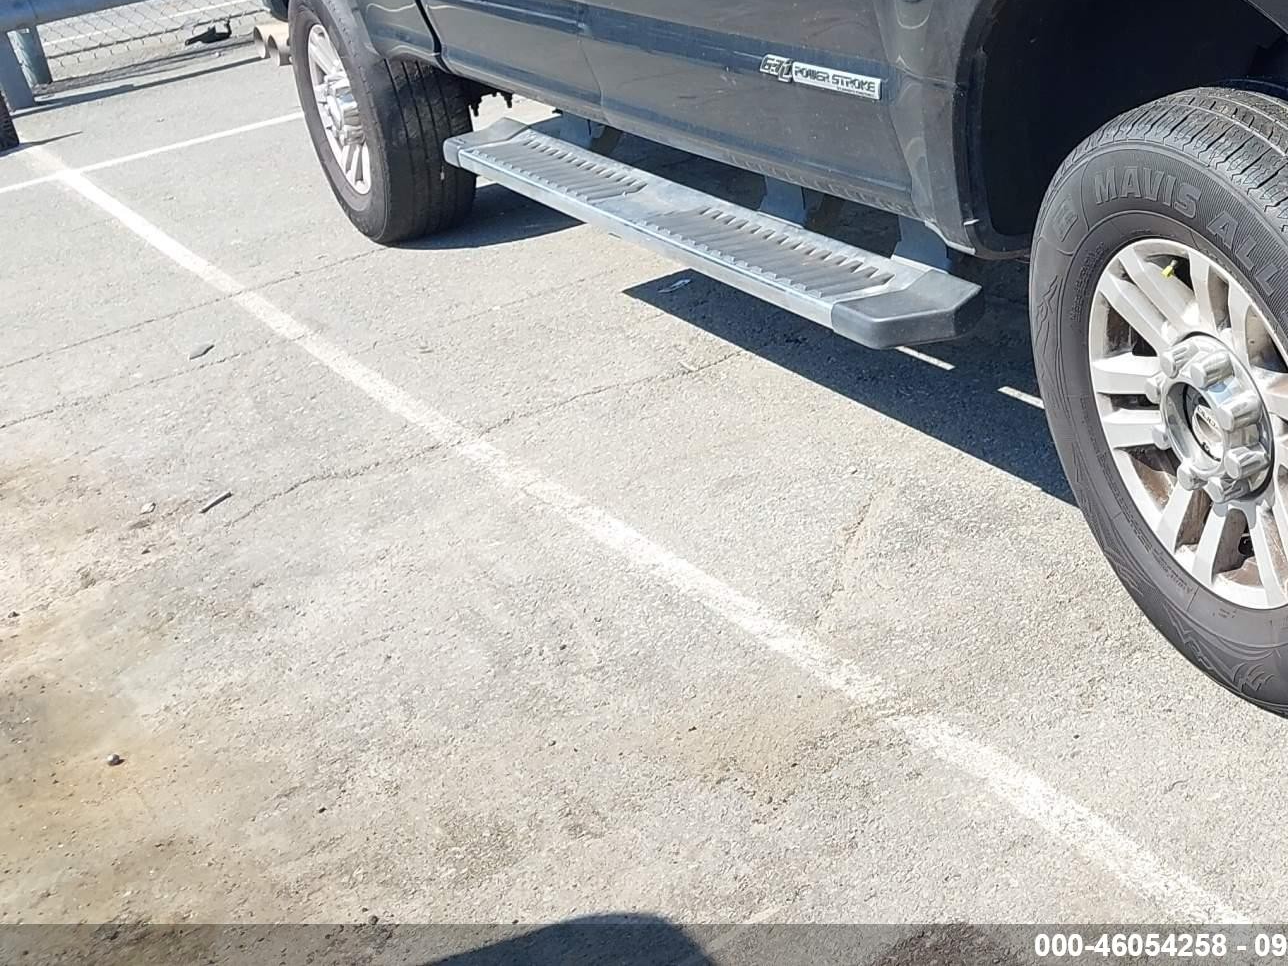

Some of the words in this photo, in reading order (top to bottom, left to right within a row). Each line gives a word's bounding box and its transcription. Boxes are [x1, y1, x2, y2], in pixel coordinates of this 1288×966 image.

[794, 65, 830, 83] POWER
[831, 74, 876, 93] STROKE
[1094, 164, 1201, 219] MAVIS
[1206, 210, 1283, 297] ALL
